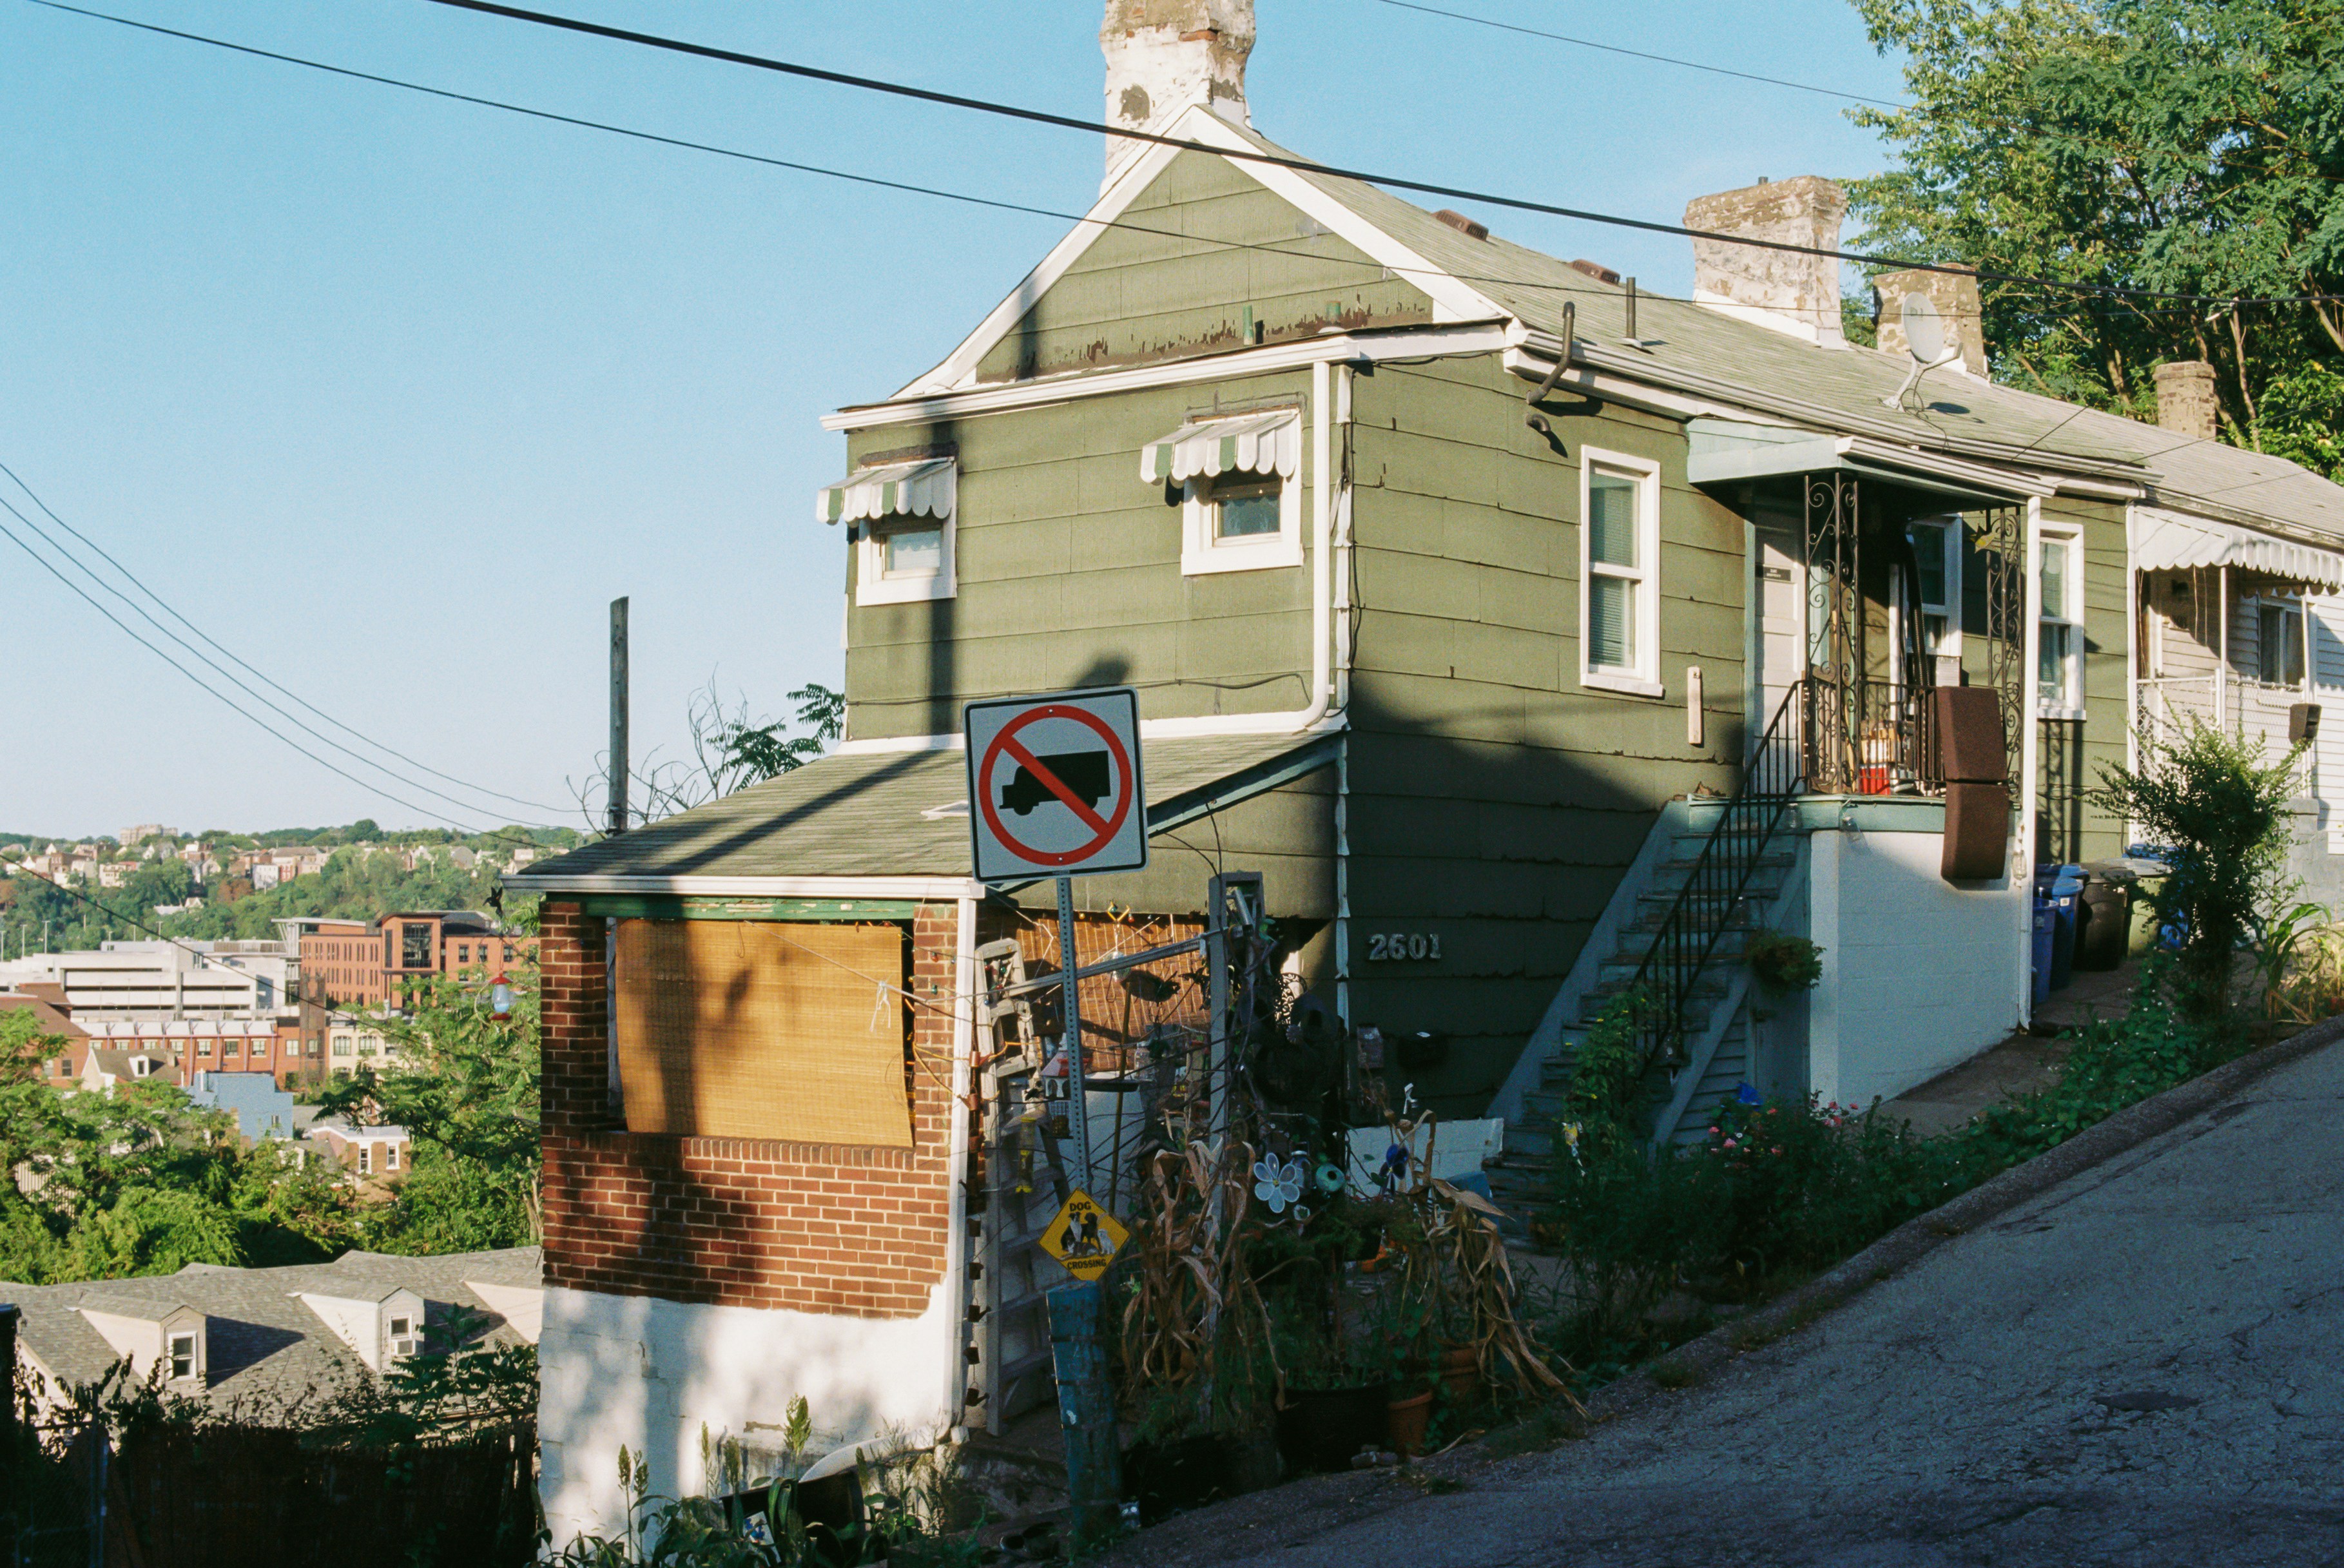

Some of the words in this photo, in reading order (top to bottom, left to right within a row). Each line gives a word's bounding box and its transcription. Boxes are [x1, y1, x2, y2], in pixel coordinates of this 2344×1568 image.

[1369, 933, 1441, 960] 2601
[1069, 1201, 1091, 1212] DOG
[1067, 1259, 1107, 1270] CROSSING
